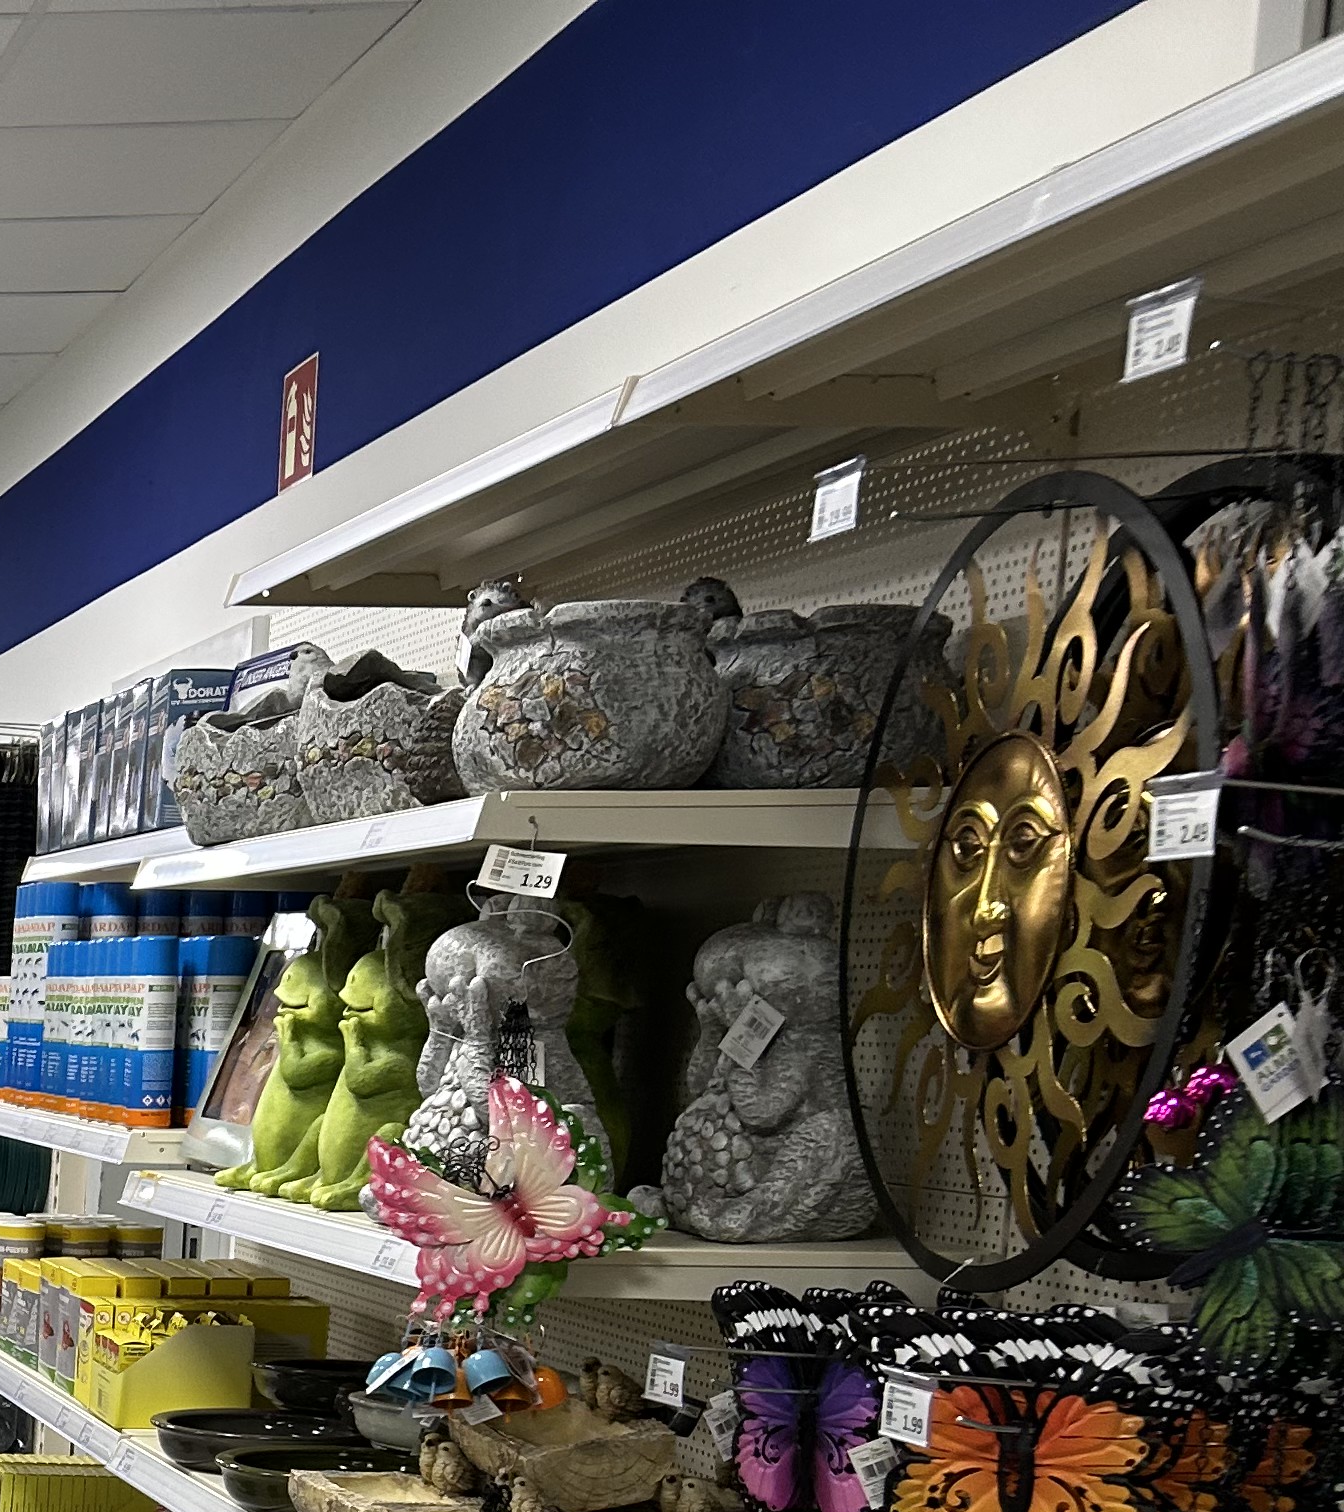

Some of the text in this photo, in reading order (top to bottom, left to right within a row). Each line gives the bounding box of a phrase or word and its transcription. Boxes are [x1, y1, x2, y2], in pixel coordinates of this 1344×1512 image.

[520, 873, 553, 889] 1.29
[663, 1381, 679, 1397] 1.99
[903, 1415, 923, 1434] 1.99
